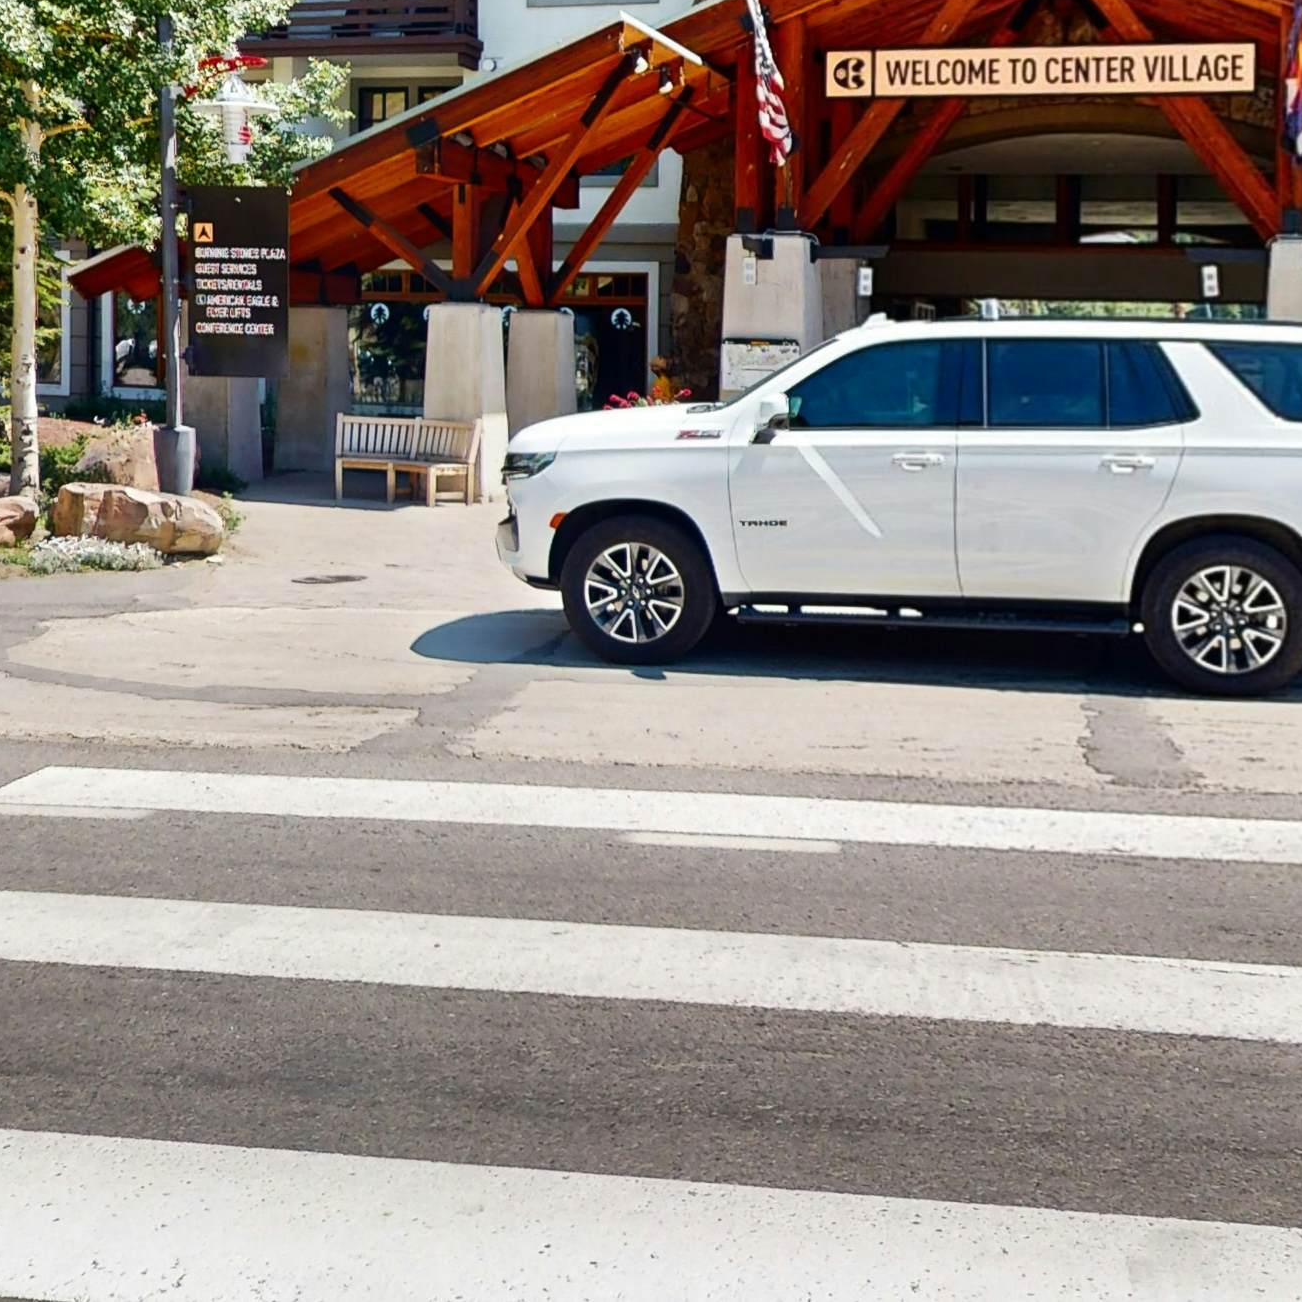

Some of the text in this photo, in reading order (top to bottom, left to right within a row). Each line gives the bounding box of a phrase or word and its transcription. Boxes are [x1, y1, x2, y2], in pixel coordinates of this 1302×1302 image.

[886, 54, 1243, 86] WELCOME TO CENTER VILLAGE
[221, 263, 257, 275] SERVICES
[206, 294, 279, 307] AMERICAN EAGLE &
[229, 307, 251, 319] LIFTS
[195, 322, 274, 335] CONFERENCE CENTER
[739, 519, 788, 527] TAHOE
